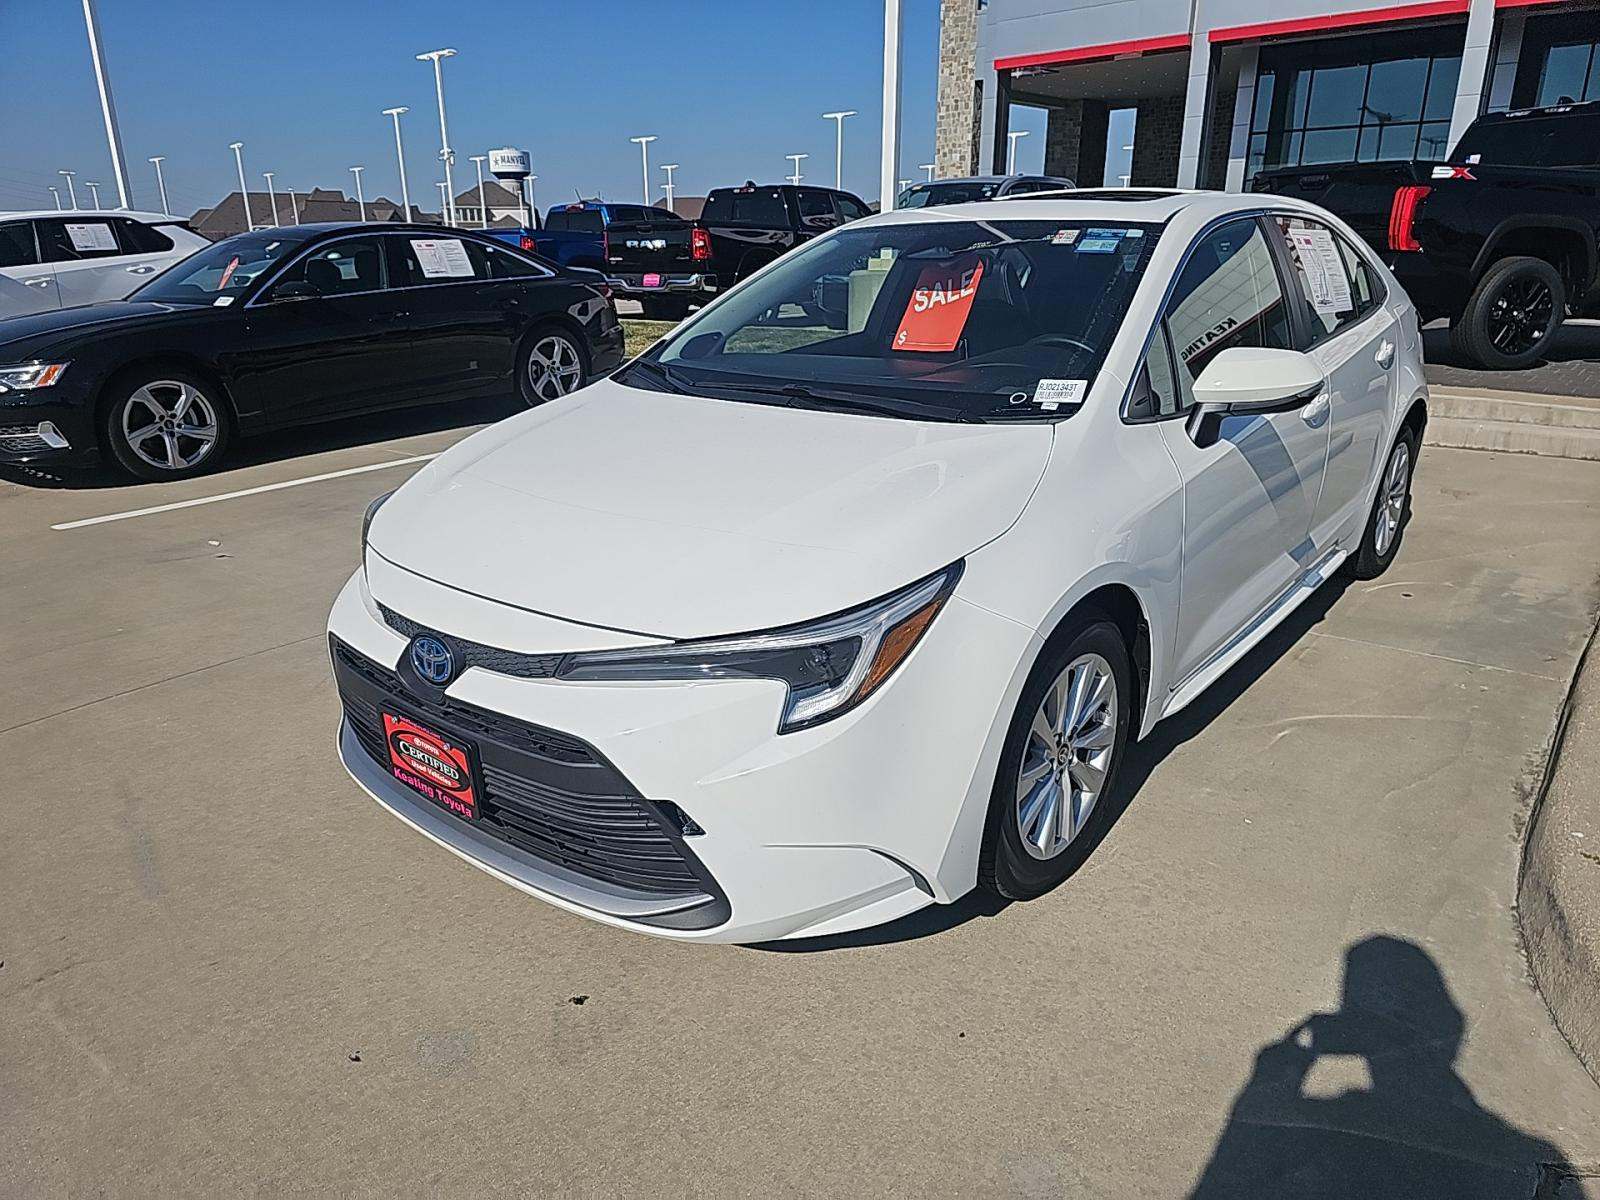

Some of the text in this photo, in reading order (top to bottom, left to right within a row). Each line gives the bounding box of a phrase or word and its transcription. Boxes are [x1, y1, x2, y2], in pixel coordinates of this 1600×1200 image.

[626, 239, 666, 250] RAM
[914, 268, 975, 312] SALE
[399, 741, 459, 780] CERTIFIED
[393, 766, 473, 818] Keating Toyota
